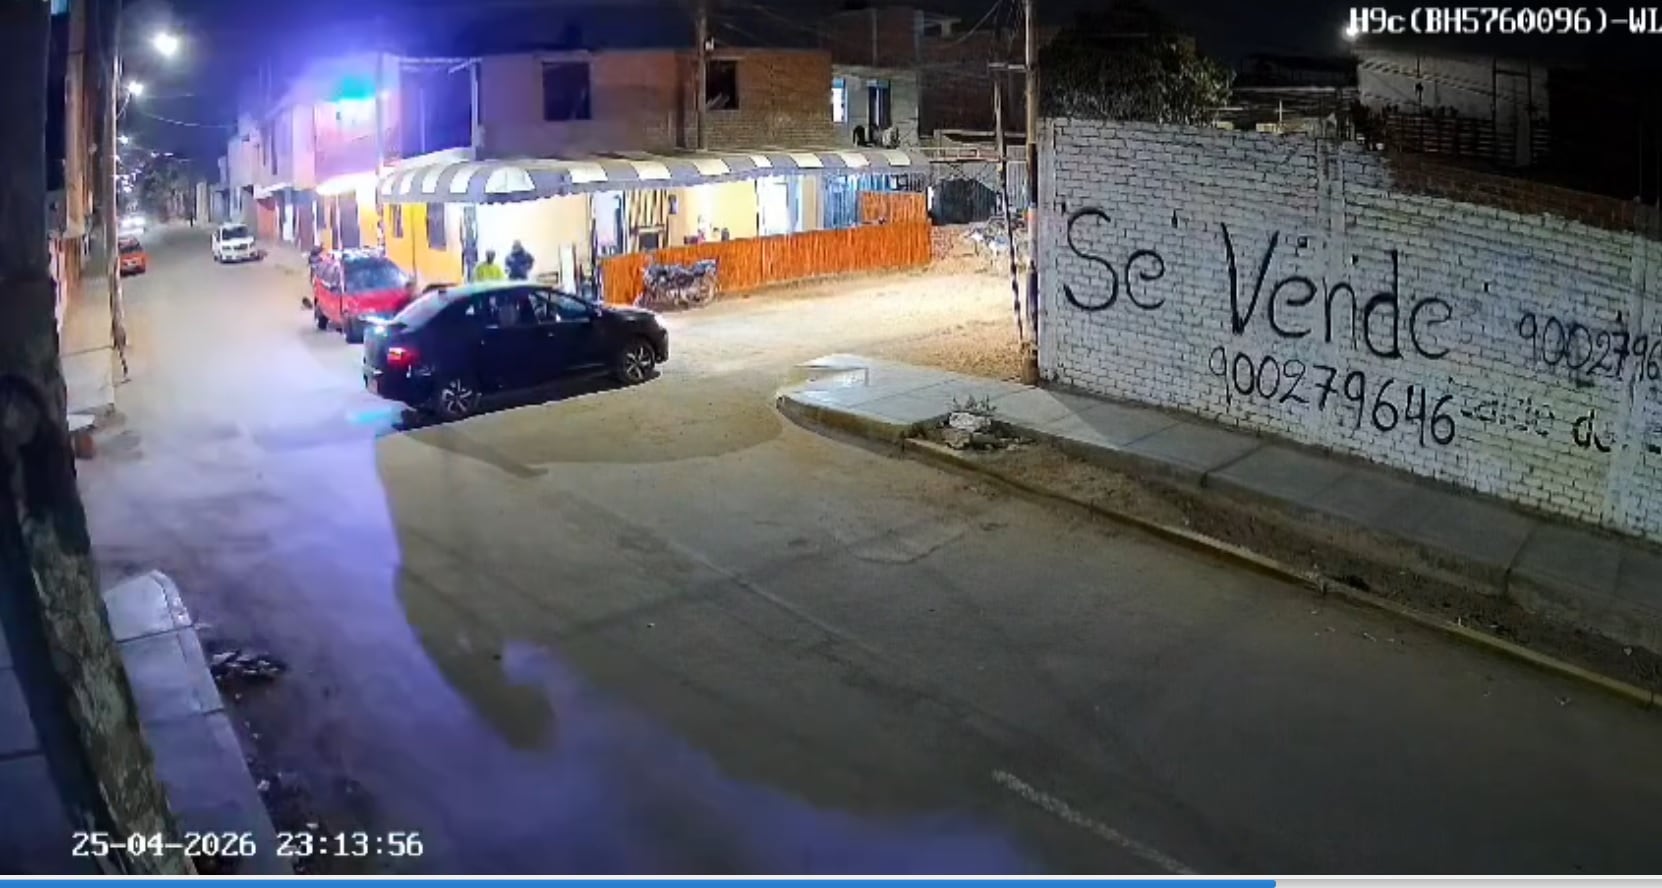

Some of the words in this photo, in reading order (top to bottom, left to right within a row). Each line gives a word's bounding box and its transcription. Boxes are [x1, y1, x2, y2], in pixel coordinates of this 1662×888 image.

[1064, 207, 1165, 311] Se
[1220, 221, 1452, 360] Vende
[1209, 346, 1455, 447] 900279646
